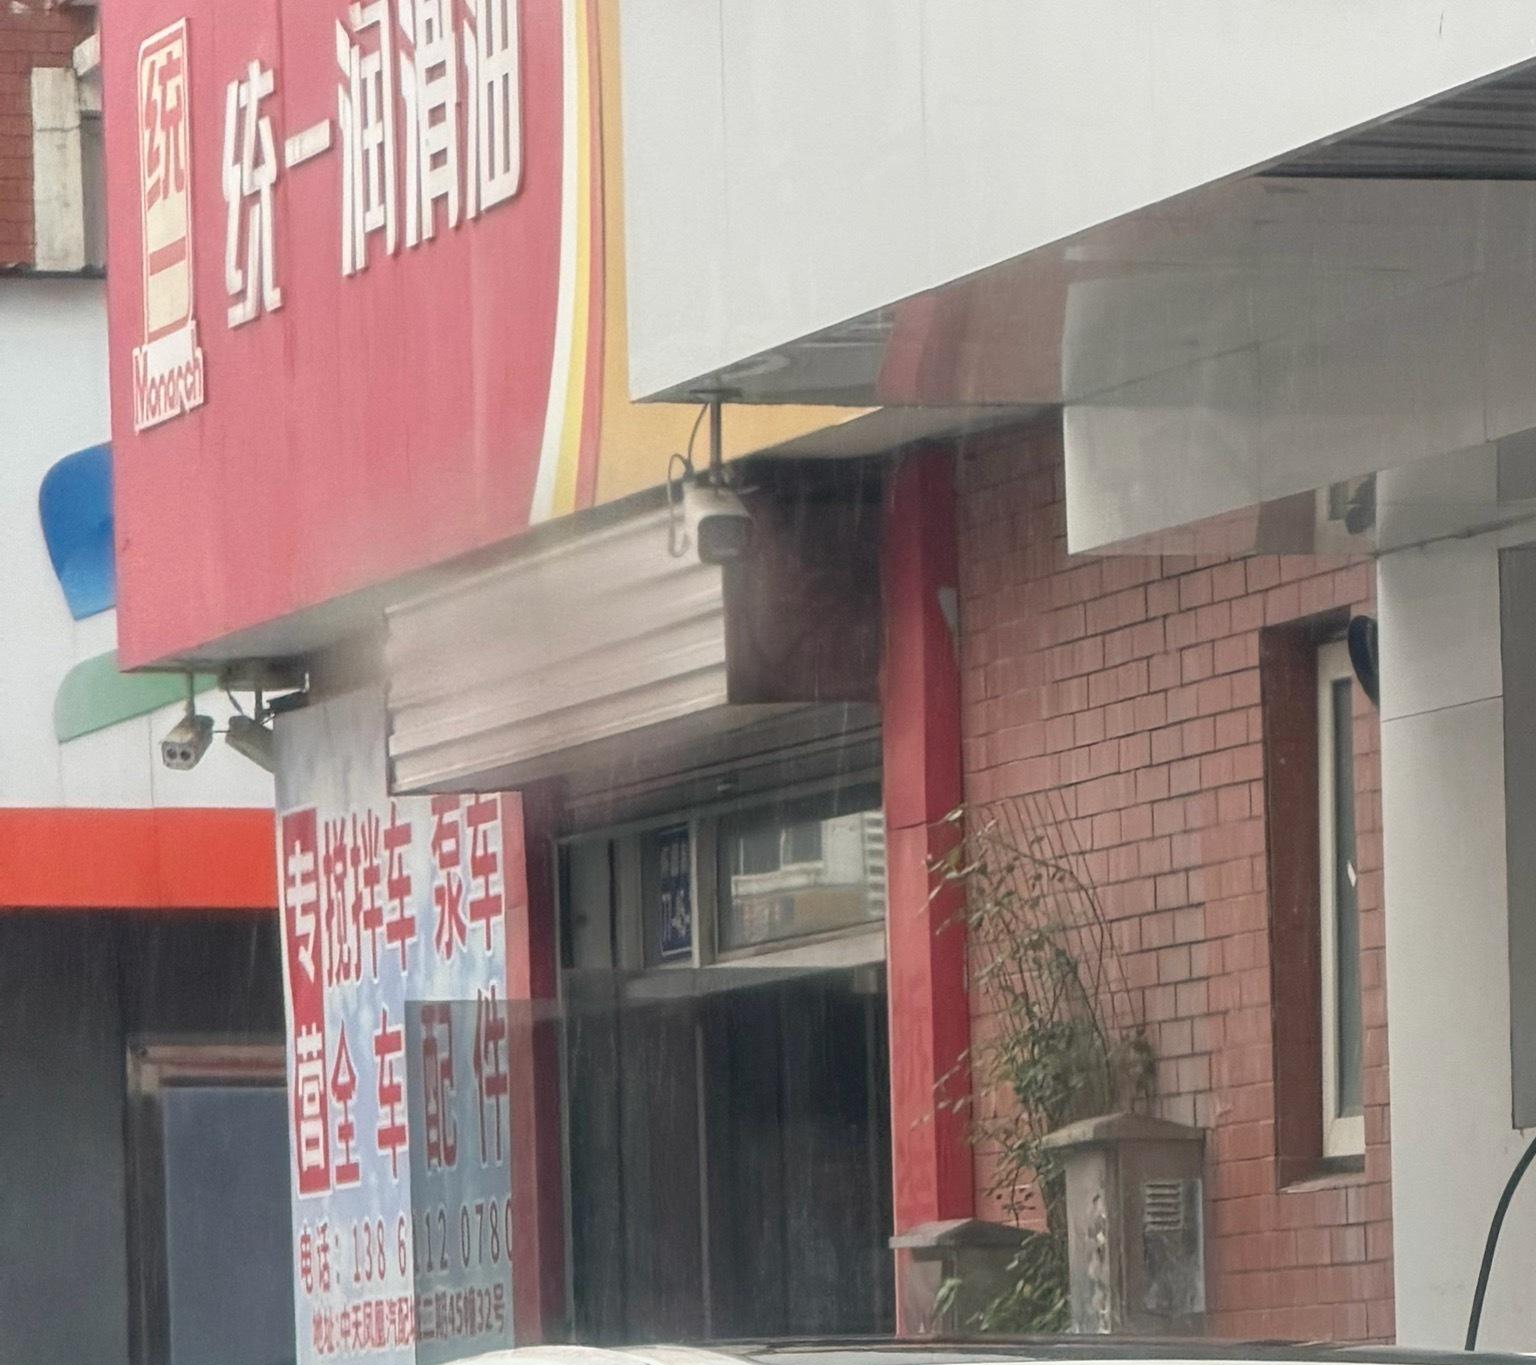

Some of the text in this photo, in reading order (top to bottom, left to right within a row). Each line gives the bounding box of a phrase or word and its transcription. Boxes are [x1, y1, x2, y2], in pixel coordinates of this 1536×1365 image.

[221, 0, 521, 329] 统一润滑油
[134, 322, 203, 431] Monarch
